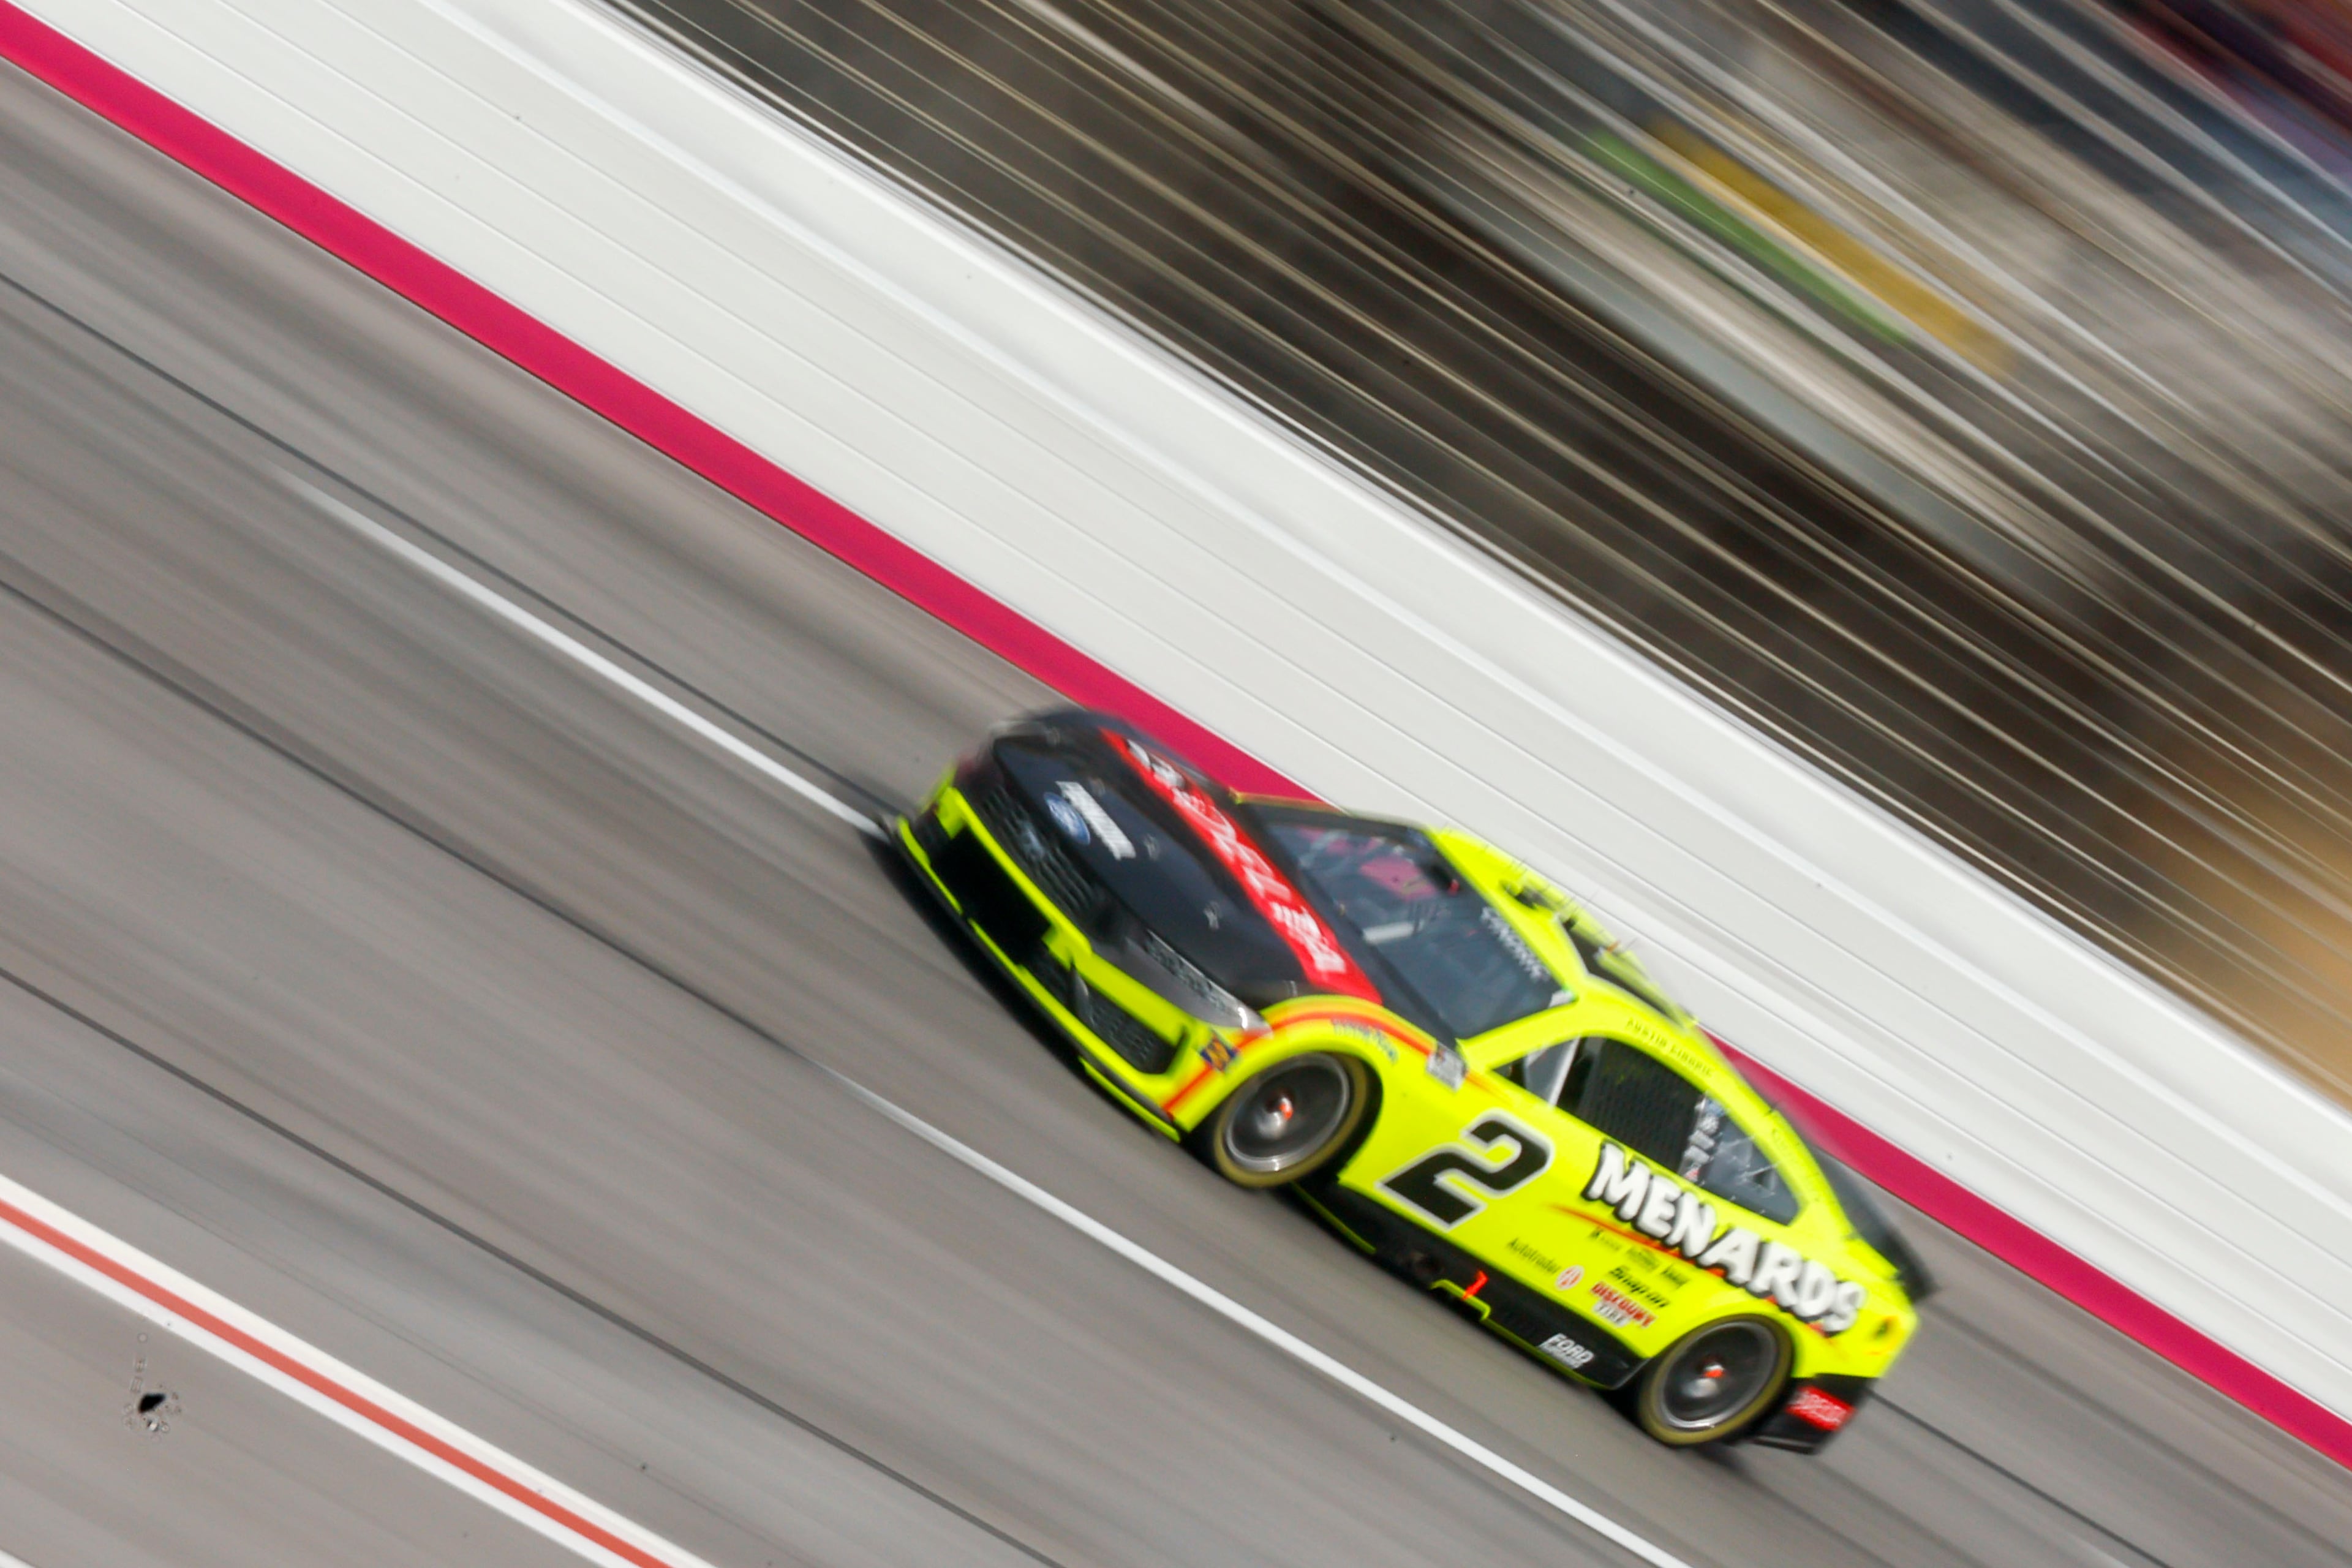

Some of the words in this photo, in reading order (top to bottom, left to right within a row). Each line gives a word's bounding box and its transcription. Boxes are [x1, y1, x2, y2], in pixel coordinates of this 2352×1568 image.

[1376, 1109, 1555, 1231] 2
[1505, 1237, 1562, 1275] Autotrader
[1580, 1139, 1866, 1336] MENARDS
[1589, 1281, 1657, 1328] DISCOUNT
[1537, 1332, 1594, 1366] FORD
